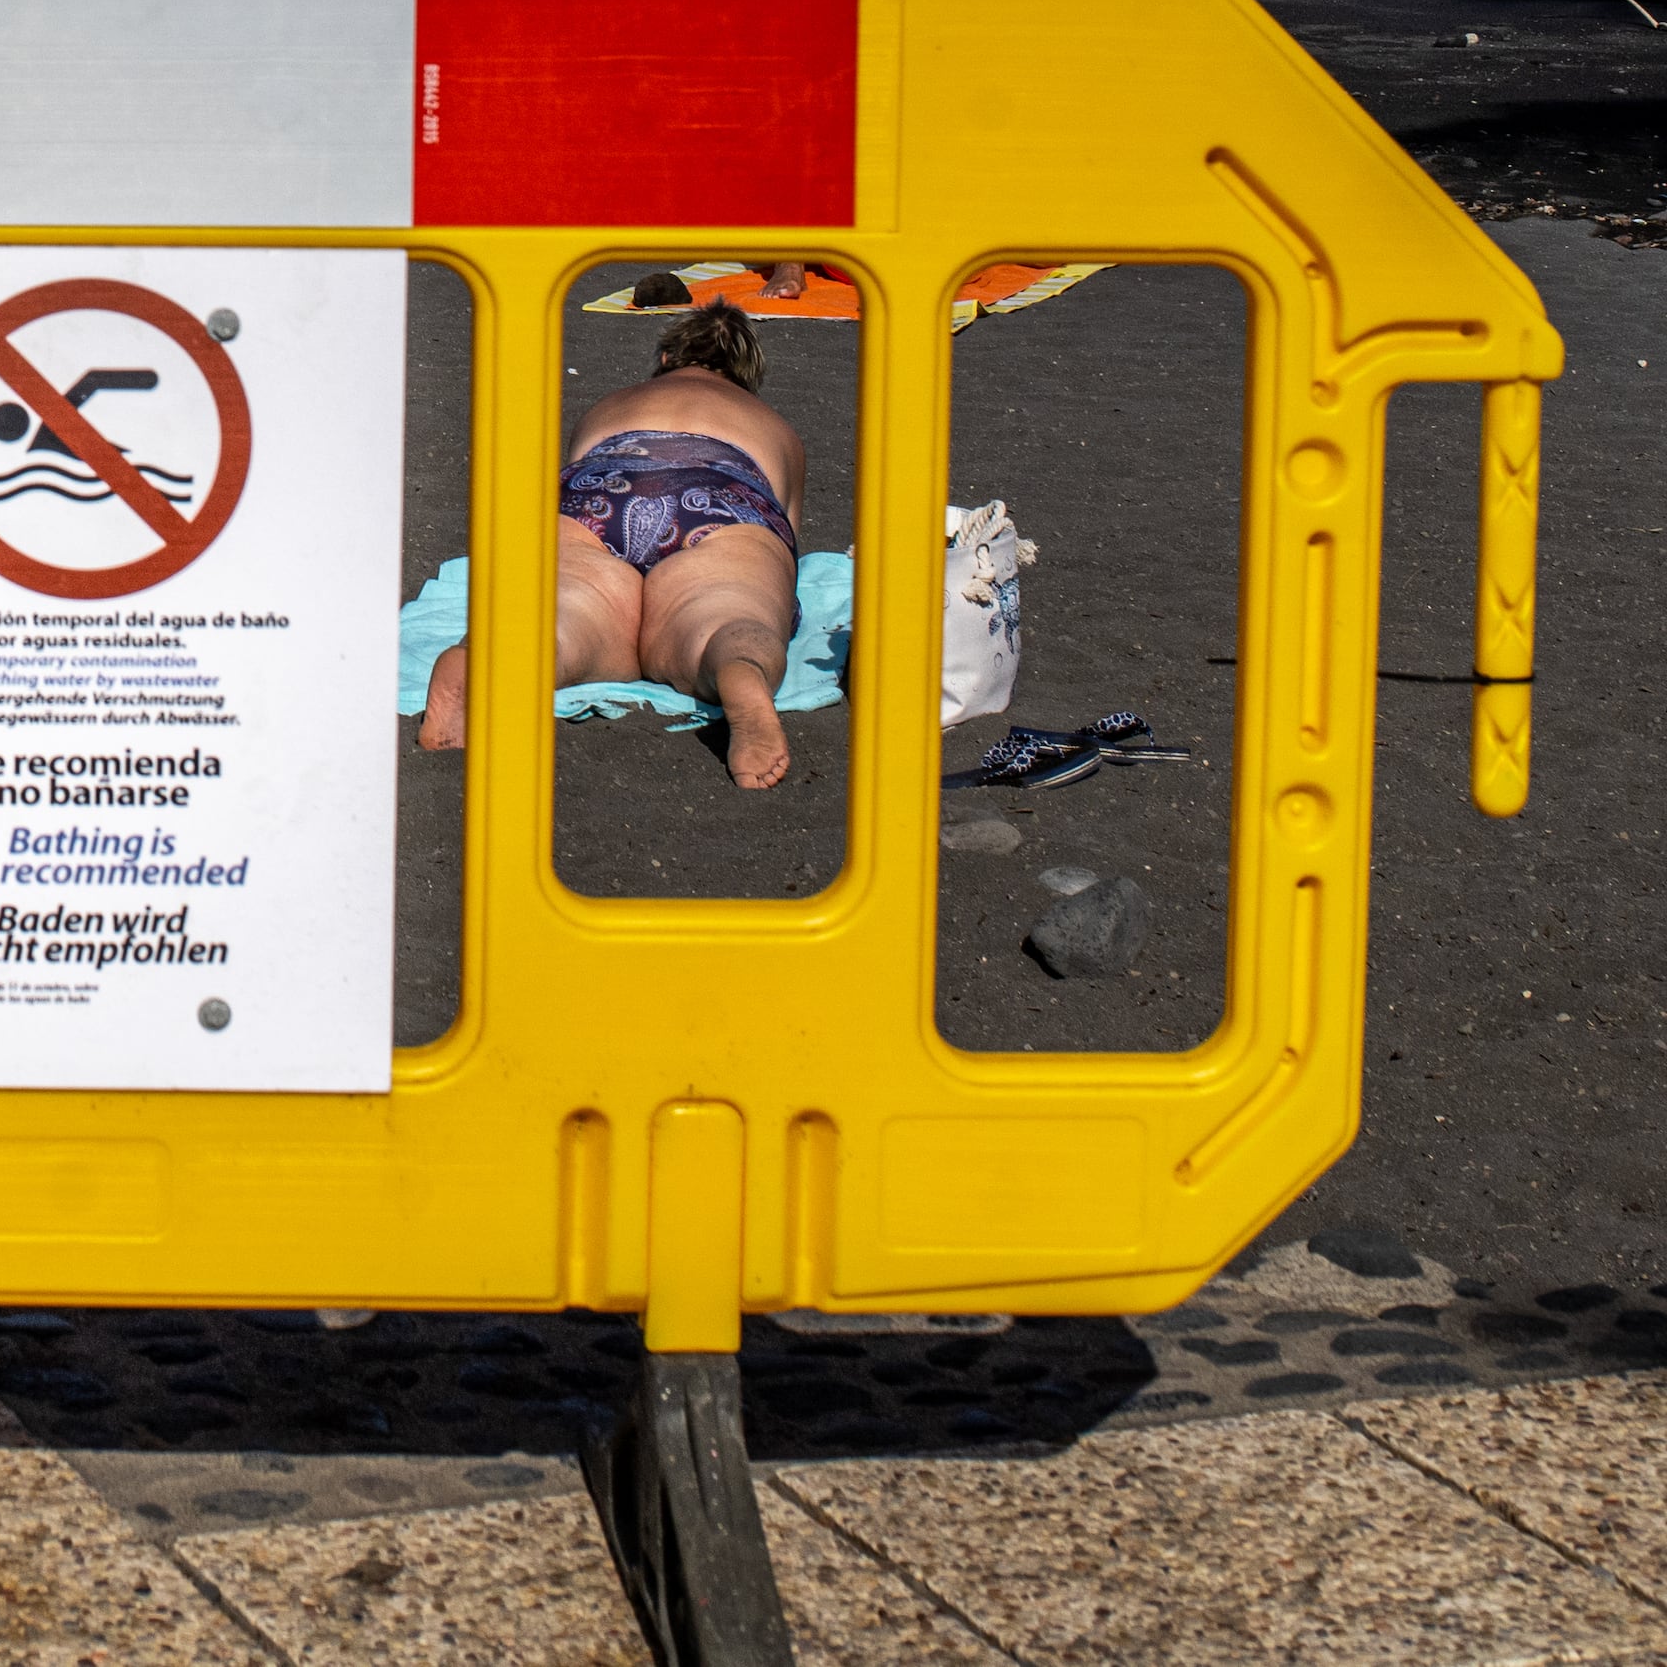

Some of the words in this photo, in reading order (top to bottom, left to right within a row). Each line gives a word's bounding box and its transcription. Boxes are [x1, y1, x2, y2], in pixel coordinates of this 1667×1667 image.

[33, 612, 120, 630] temporal
[126, 612, 154, 628] del
[160, 615, 207, 631] agua
[212, 612, 236, 628] de
[241, 612, 290, 629] baño
[23, 636, 78, 651] aguas
[84, 633, 187, 650] residuales.
[70, 654, 198, 668] contamination
[43, 674, 92, 687] water
[96, 673, 116, 689] by
[121, 674, 220, 688] wastewater
[93, 691, 225, 708] Verschmutzung
[103, 711, 150, 726] durch
[155, 710, 241, 726] Abwässer.
[14, 747, 222, 777] recomienda
[50, 776, 190, 806] bañarse
[8, 827, 143, 862] Bathing
[150, 827, 176, 855] is
[1, 857, 250, 886] recommended
[113, 905, 189, 934] wird
[45, 934, 229, 970] empfohlen
